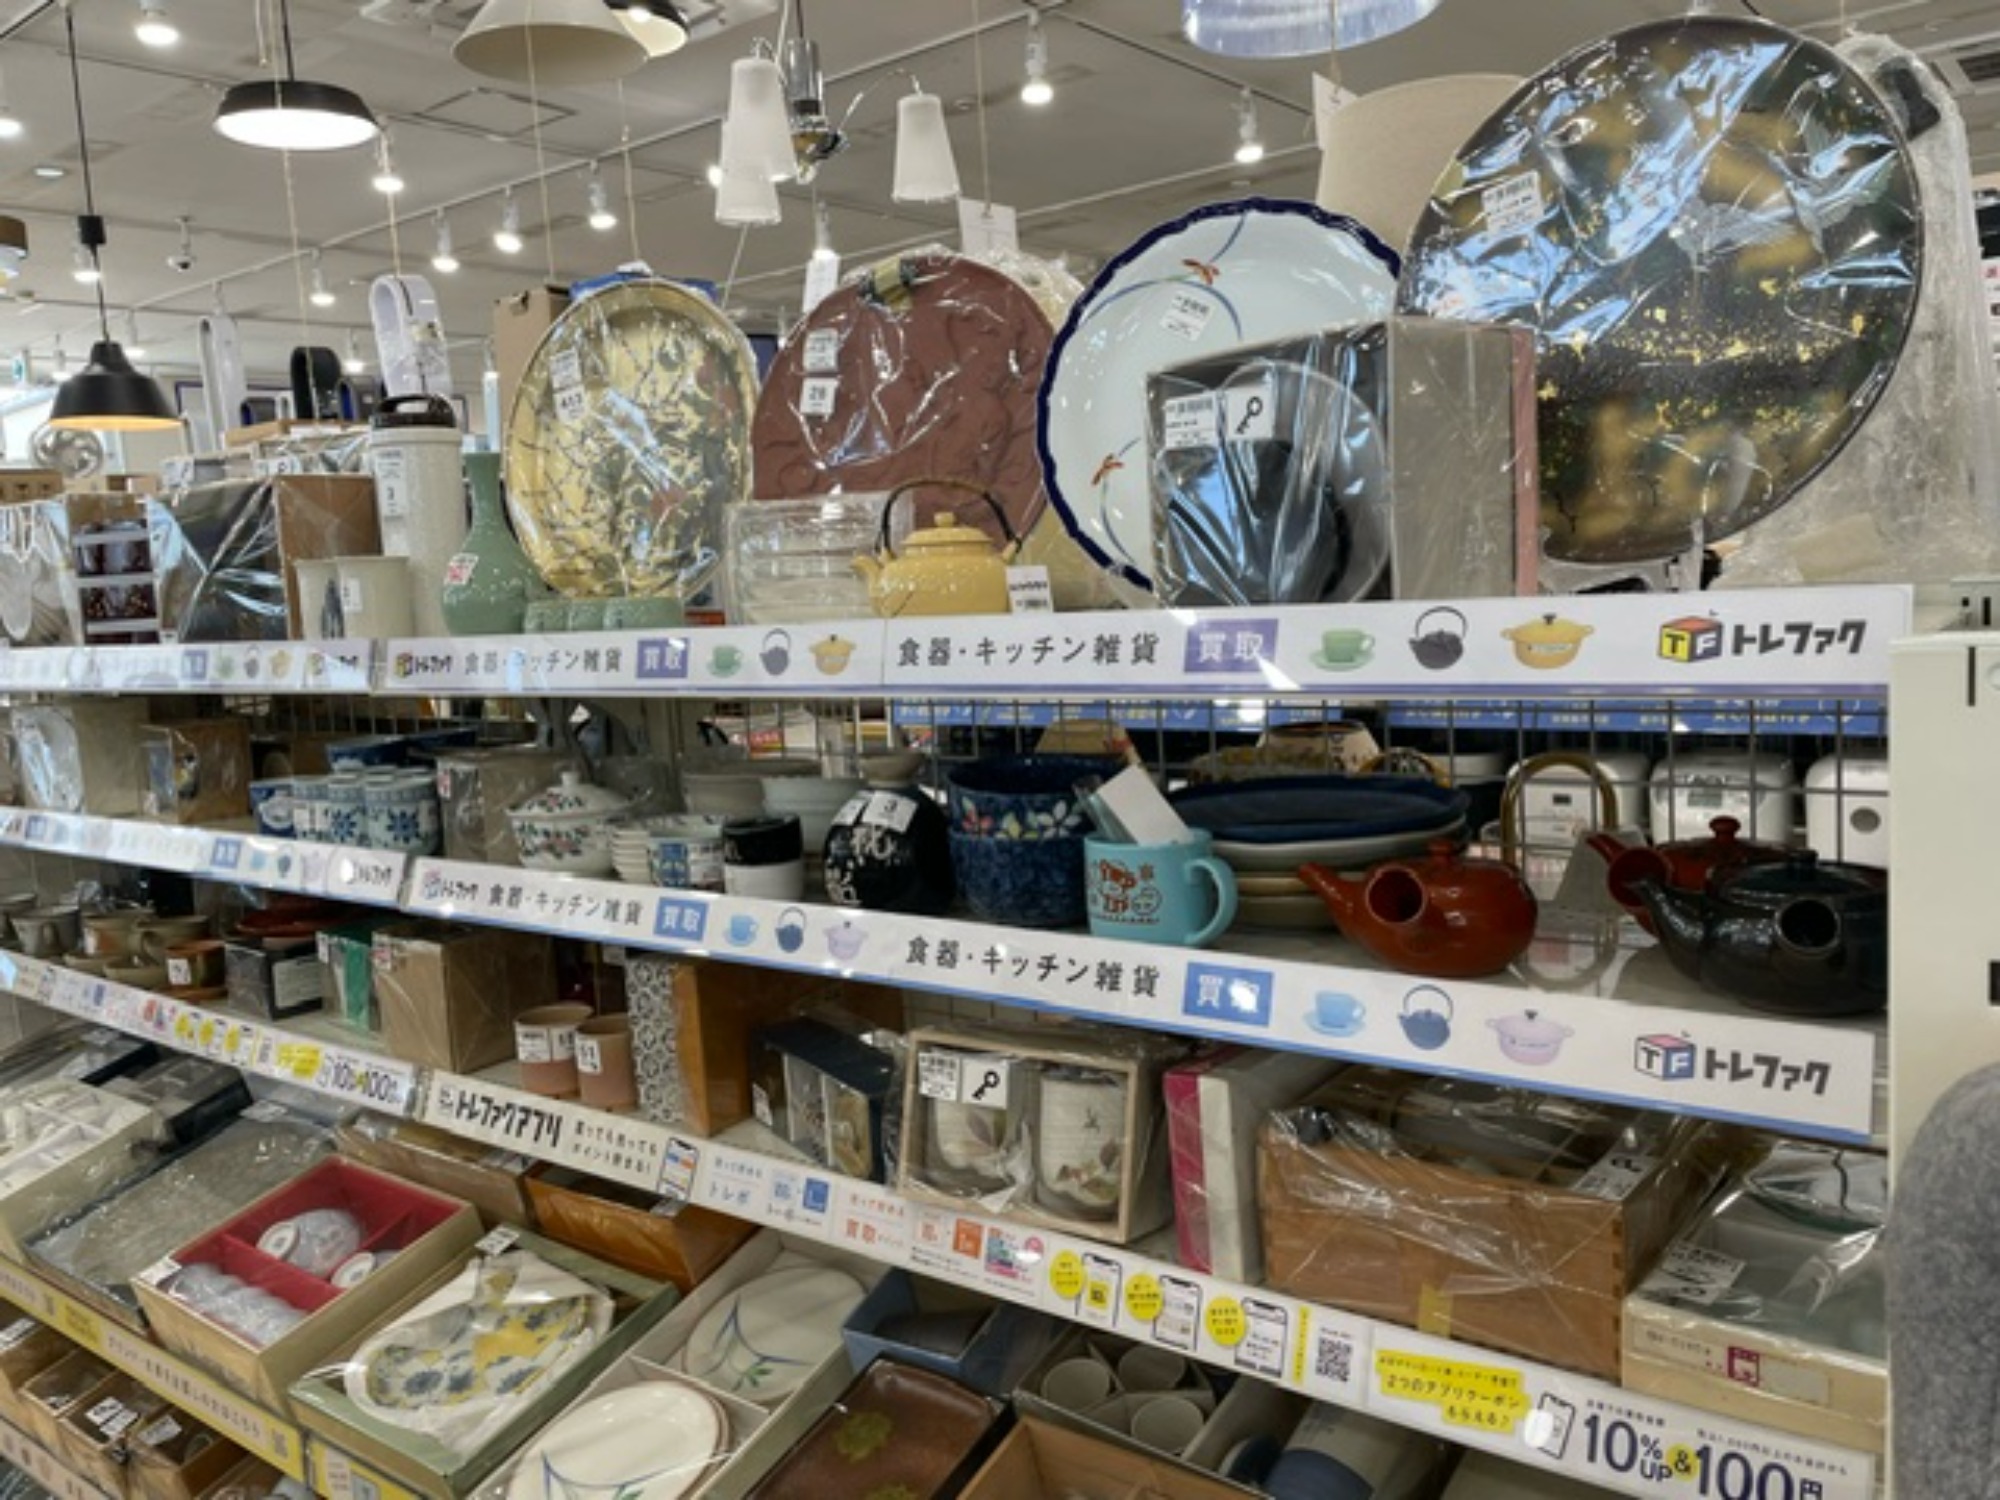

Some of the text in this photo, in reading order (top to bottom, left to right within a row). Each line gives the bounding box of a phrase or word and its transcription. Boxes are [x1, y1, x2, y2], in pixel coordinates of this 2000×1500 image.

[897, 632, 1162, 667] 食器・キッチン雑貨
[1198, 630, 1265, 663] 買取
[1732, 620, 1867, 656] トレファク
[488, 884, 644, 926] 食器・キッチン雑貨
[661, 905, 701, 933] 買取
[905, 936, 1161, 998] 食器・キッチン雑貨
[1705, 1048, 1832, 1095] トレファク
[455, 1090, 564, 1148] トレファクアプリ
[1674, 1449, 1691, 1472] &
